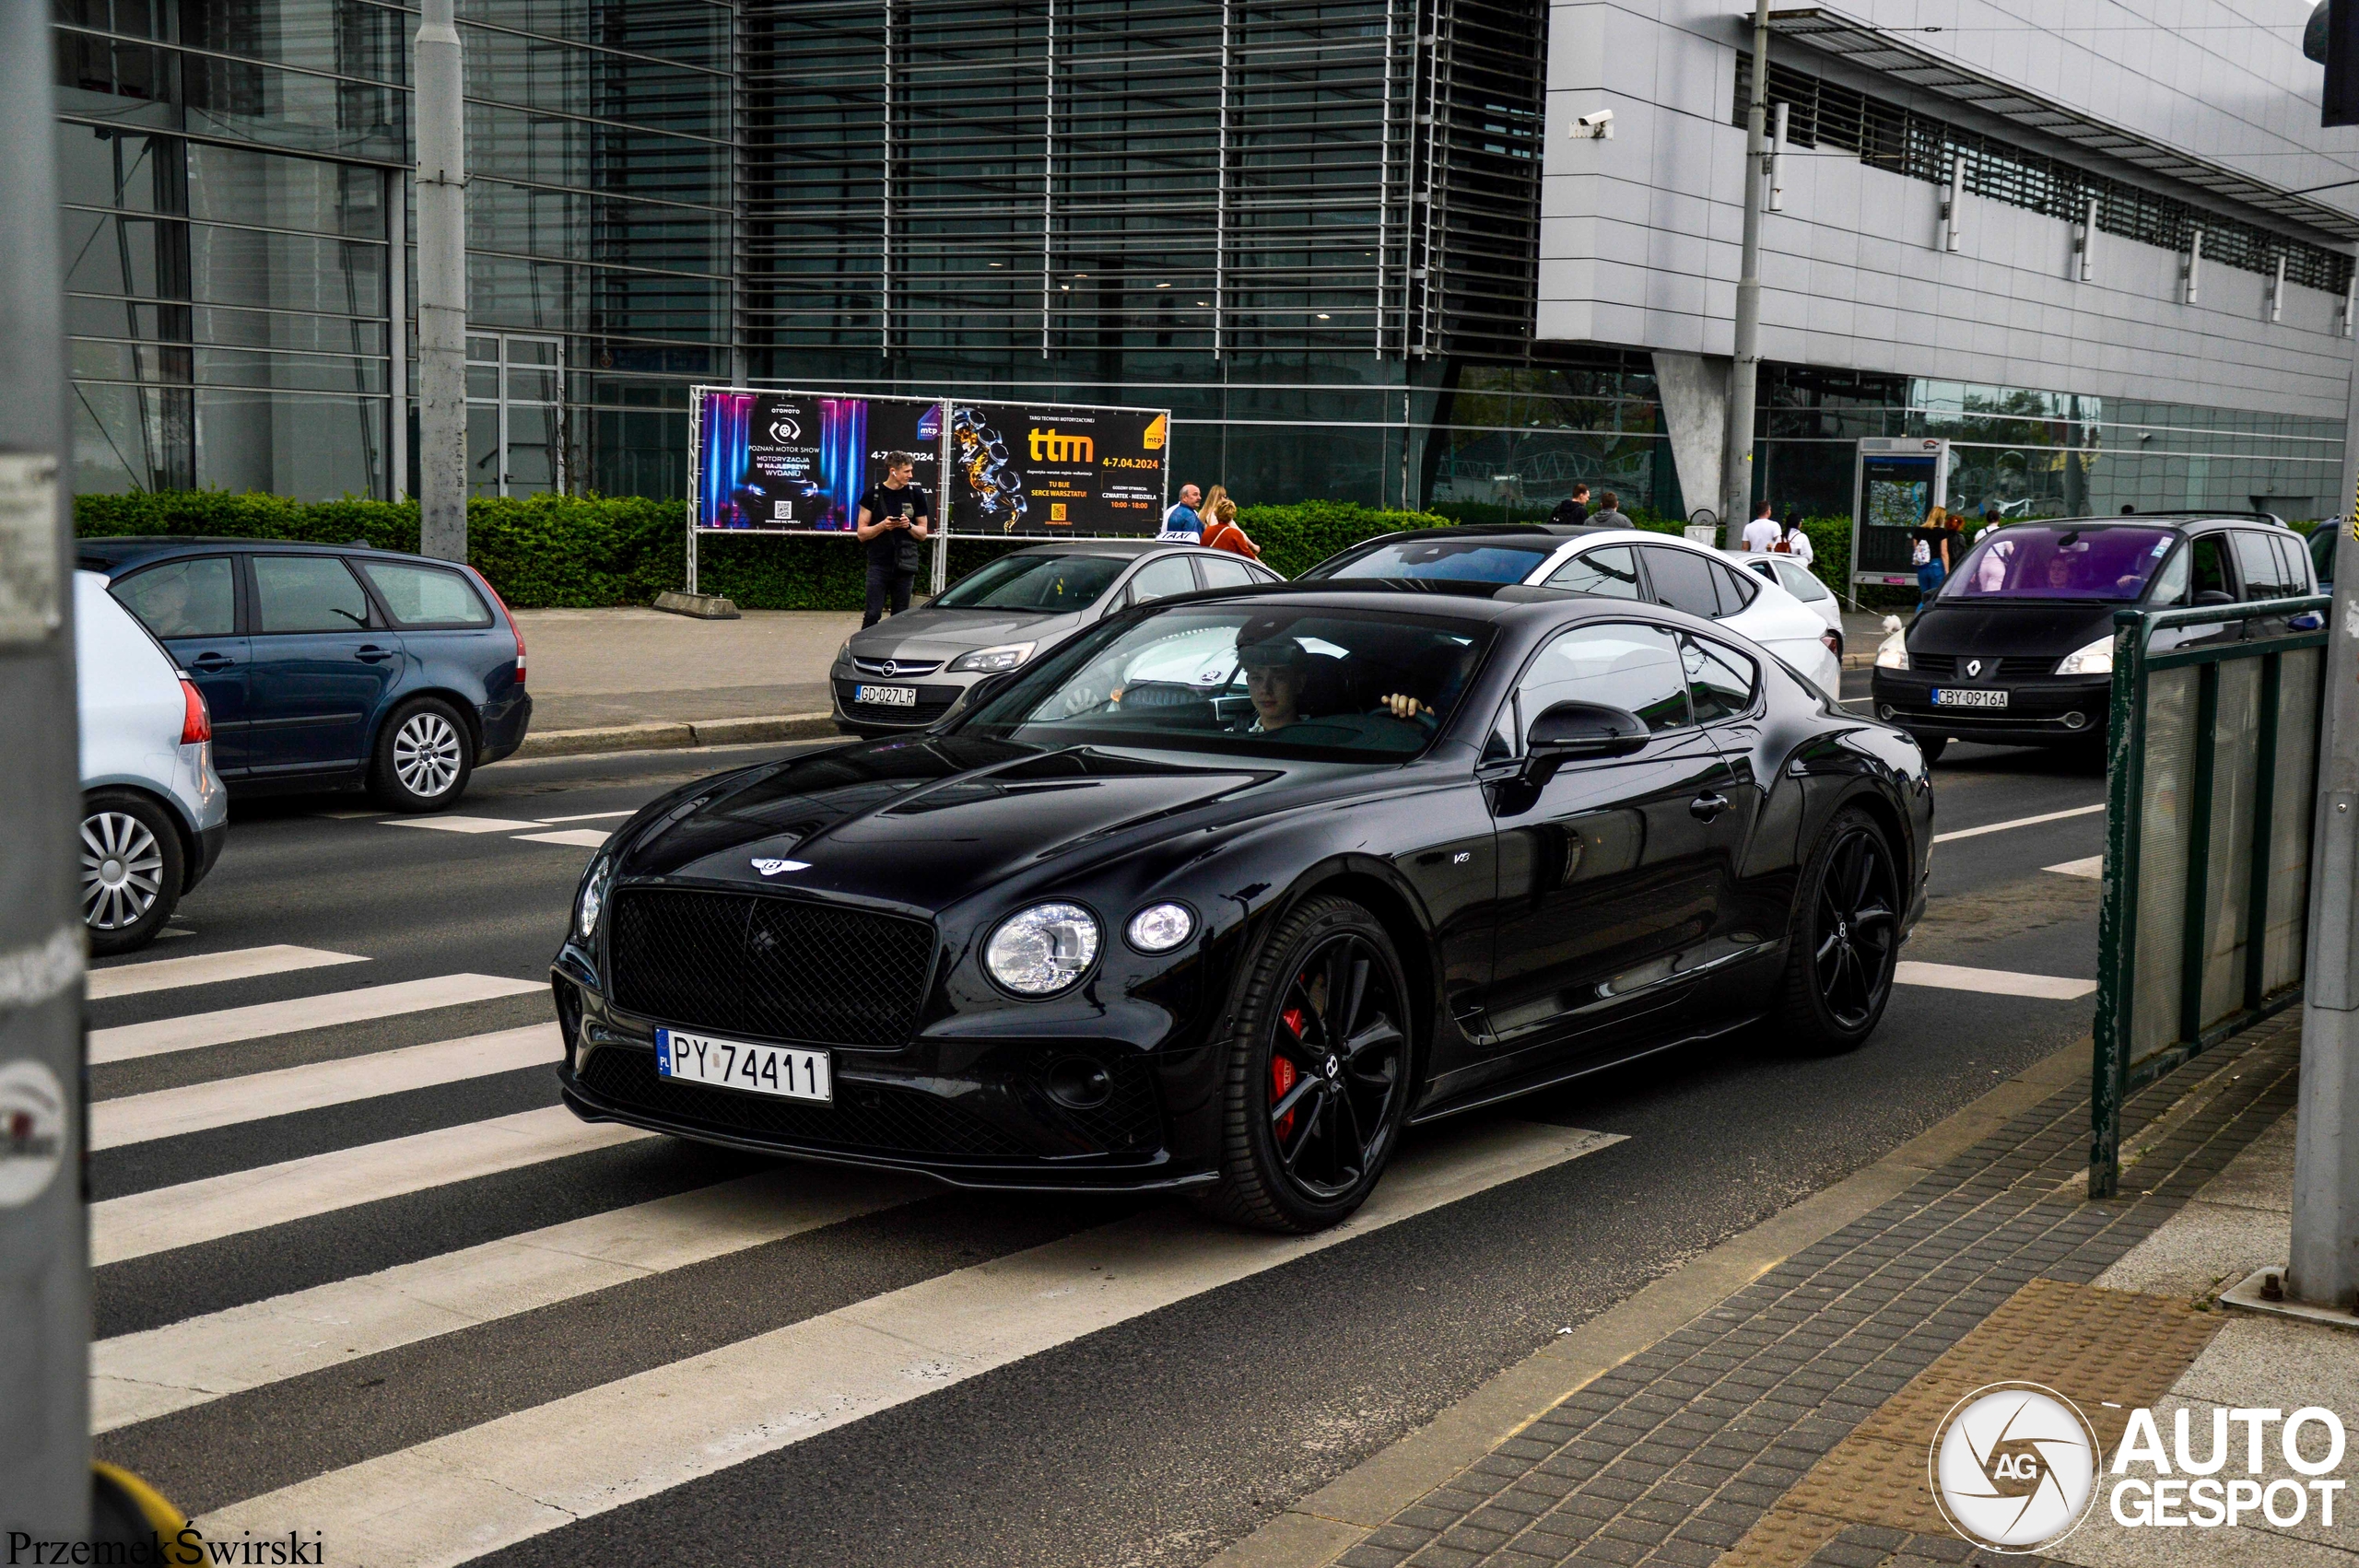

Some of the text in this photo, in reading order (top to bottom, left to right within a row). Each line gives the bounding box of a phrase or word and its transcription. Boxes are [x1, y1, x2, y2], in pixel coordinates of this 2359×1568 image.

[921, 427, 937, 436] mtp
[1027, 427, 1094, 462] ttm
[1102, 457, 1159, 469] 4-7.04.2024
[1162, 532, 1191, 540] TAXI
[862, 686, 876, 701] GD
[879, 688, 914, 704] 027LR
[1939, 690, 2006, 706] CBY 0916A
[1454, 852, 1470, 864] V8
[660, 1056, 670, 1068] PL
[674, 1036, 816, 1094] PY 74411
